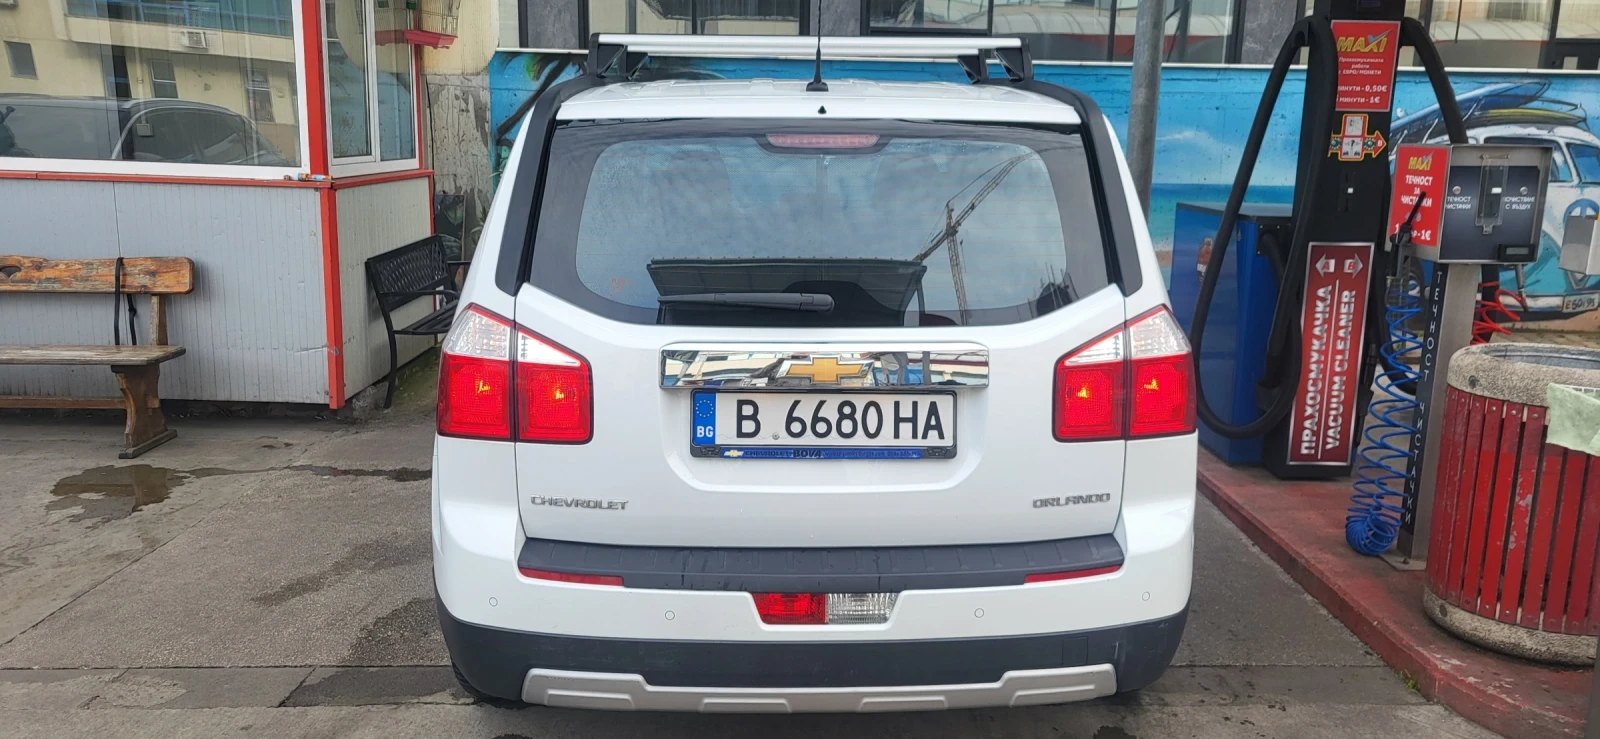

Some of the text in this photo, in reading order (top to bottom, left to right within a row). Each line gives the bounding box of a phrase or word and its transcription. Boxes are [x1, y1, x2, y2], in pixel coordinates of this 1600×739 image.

[1336, 36, 1388, 53] MAXI
[1365, 84, 1388, 93] 0,50€
[1408, 156, 1433, 171] MAXI
[1406, 174, 1433, 186] ТЕЧНОСТ
[1300, 285, 1332, 454] ПРАХОСМУКАЧКА
[1325, 290, 1356, 449] VACUUM CLEANER
[1405, 271, 1443, 524] ТЕЧНОСТ ЧИСТАЧКИ
[696, 399, 945, 440] BG B 6680 HA
[793, 448, 822, 458] BOVA
[530, 493, 629, 511] CHEVROLET
[1032, 492, 1111, 509] ORLANDO
